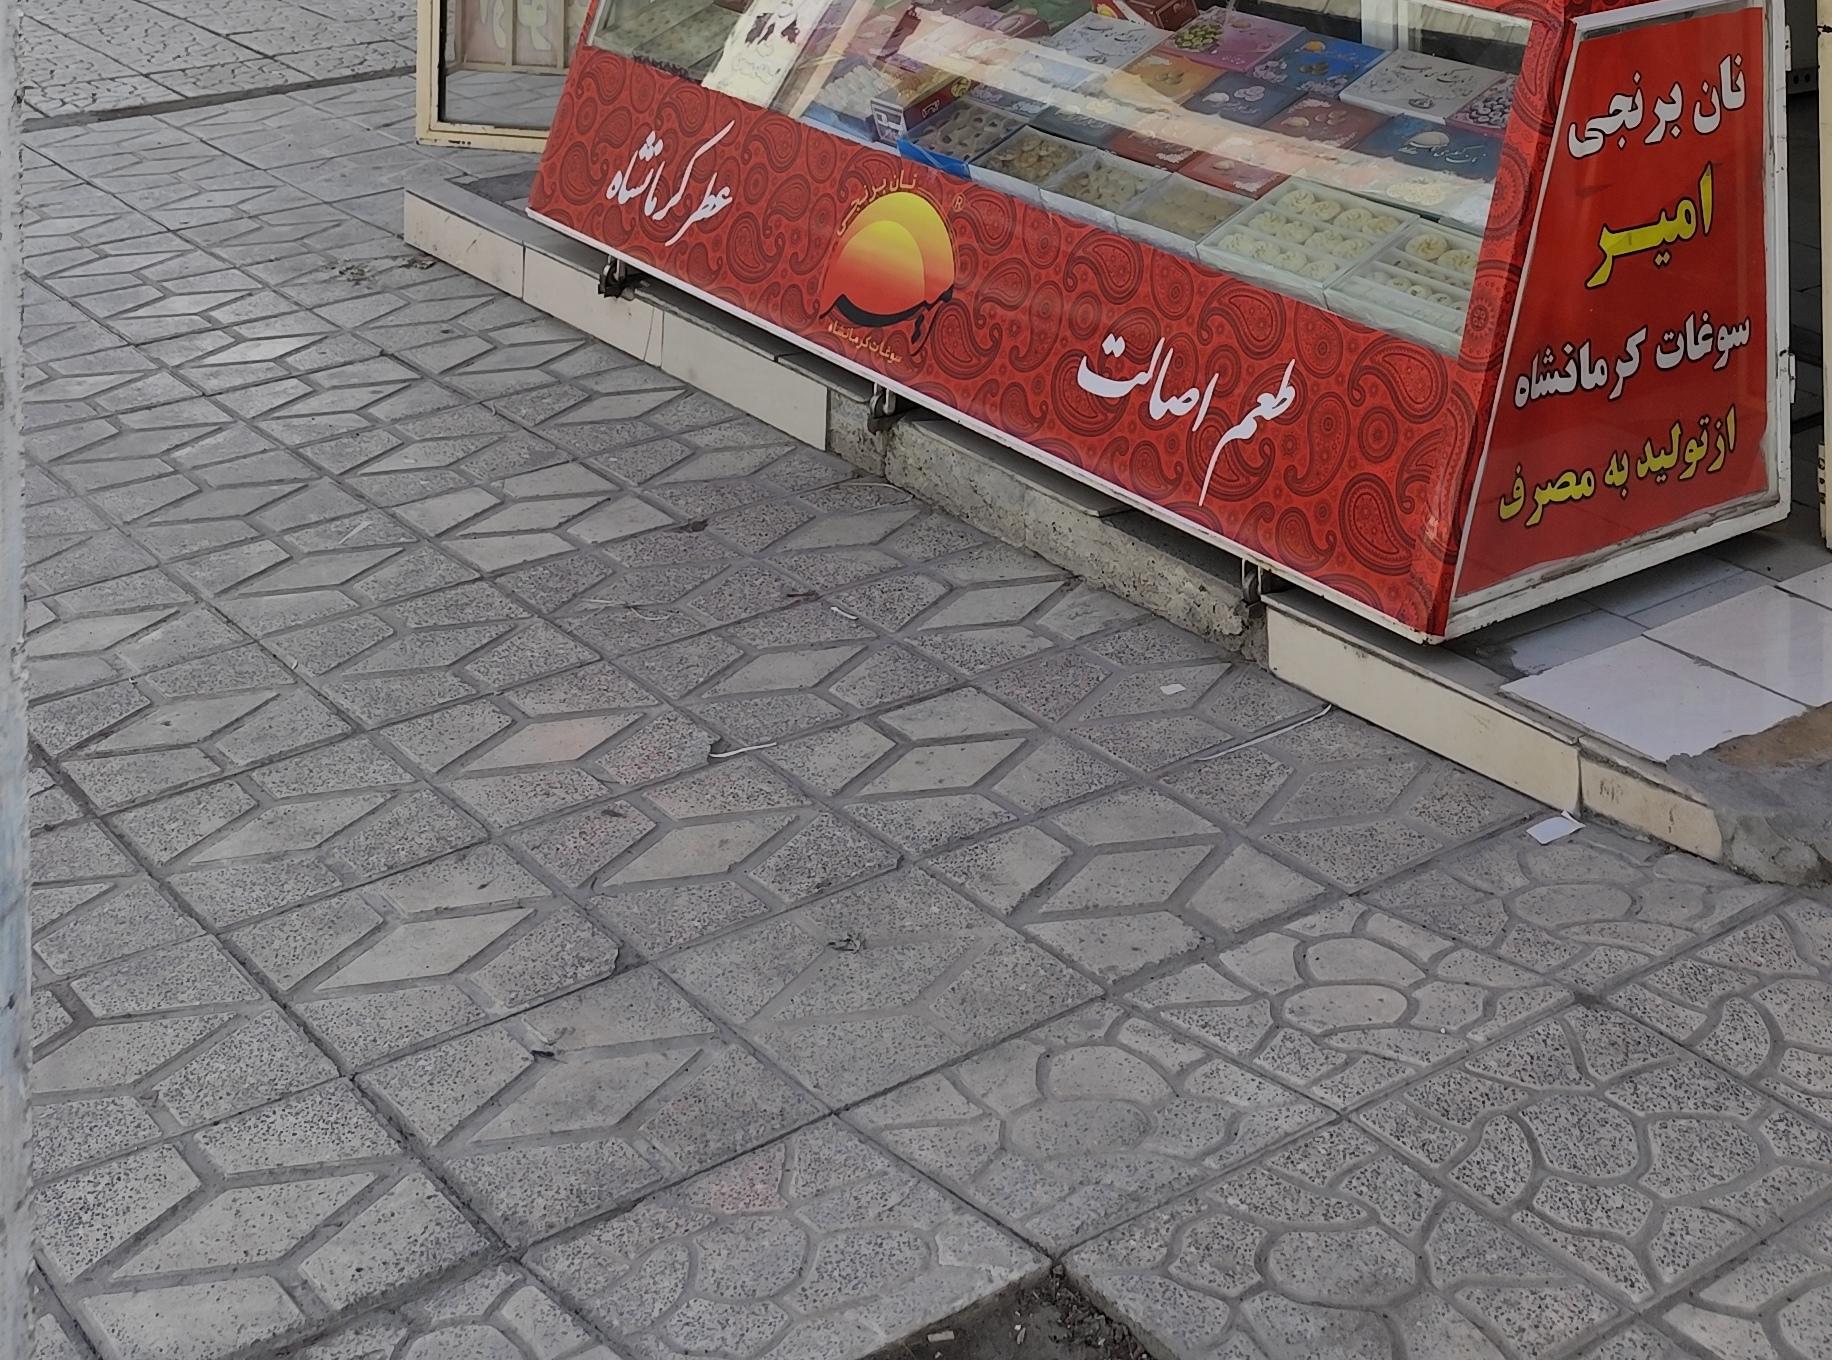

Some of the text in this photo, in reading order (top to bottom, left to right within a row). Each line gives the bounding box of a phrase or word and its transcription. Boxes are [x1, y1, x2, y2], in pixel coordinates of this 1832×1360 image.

[1567, 53, 1747, 159] نان برنجی
[605, 119, 735, 247] عطر کرمانشاه
[1585, 160, 1715, 289] امیر
[1513, 311, 1752, 409] سوغات کرمانشاه
[1077, 332, 1297, 507] طعم اصالت
[1499, 462, 1597, 528] مصرف
[1603, 451, 1630, 501] به
